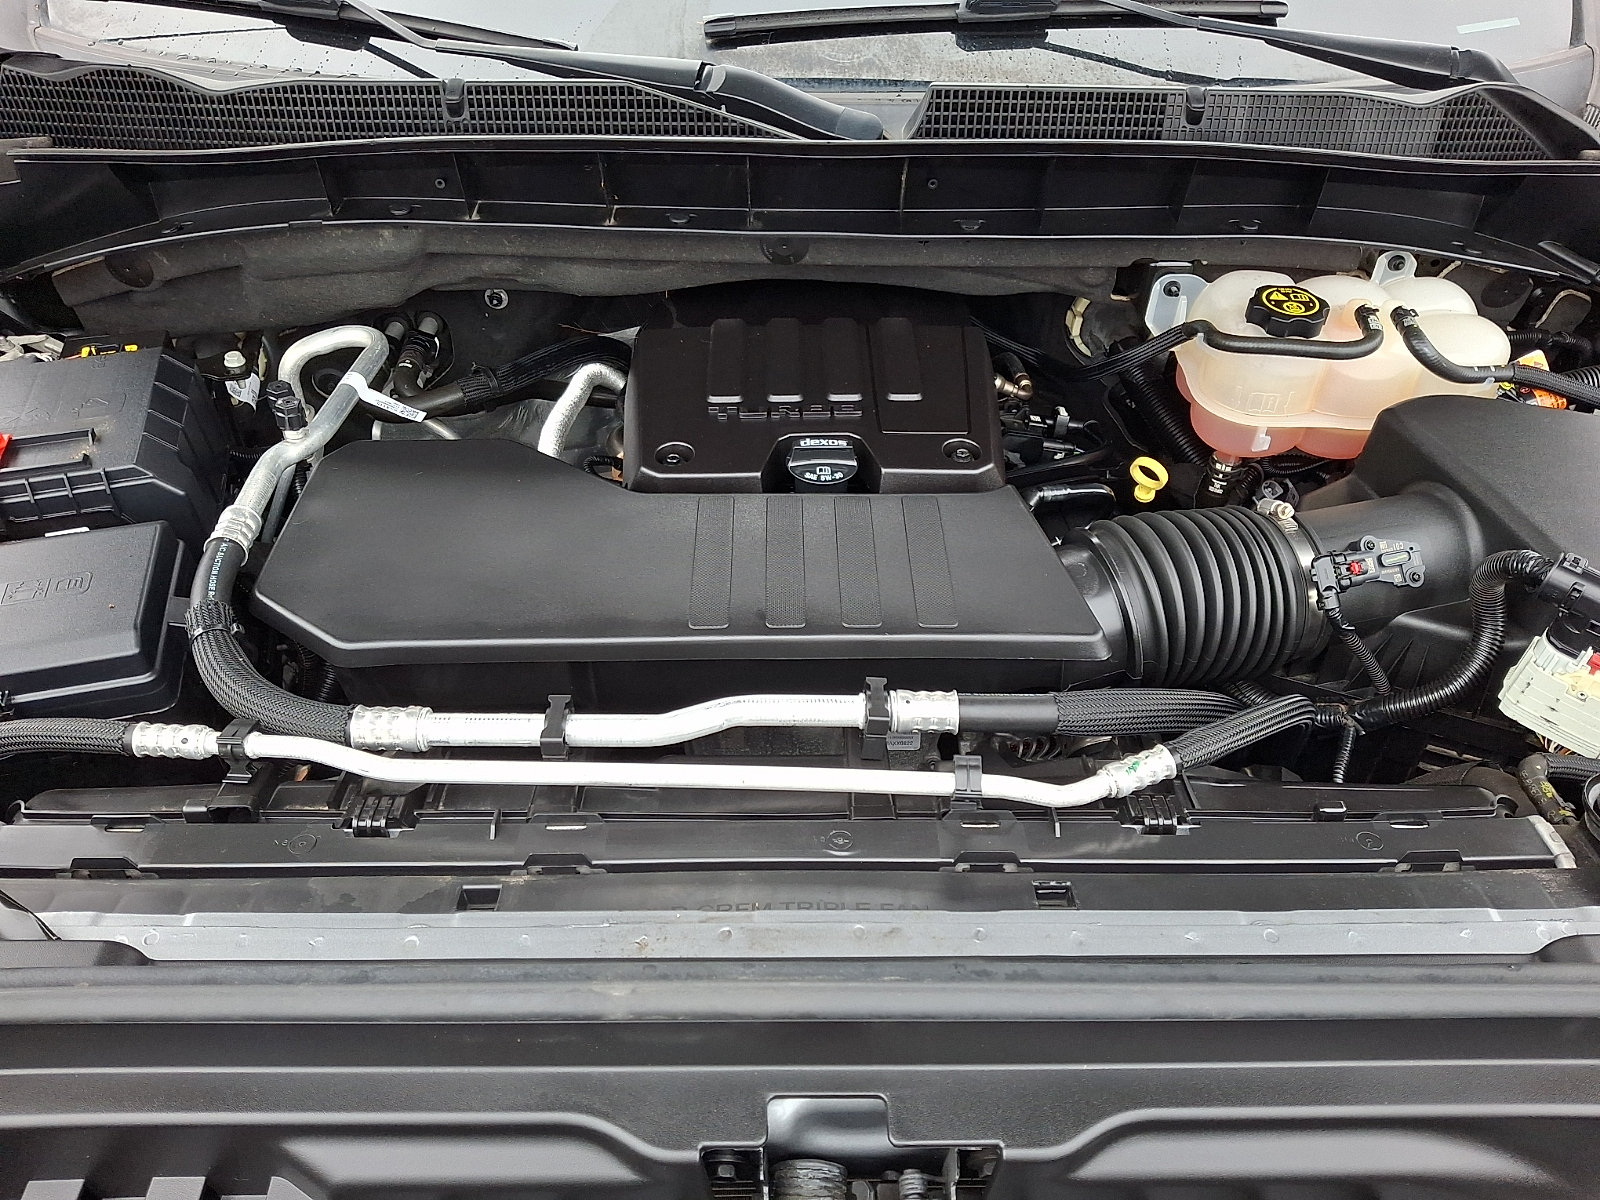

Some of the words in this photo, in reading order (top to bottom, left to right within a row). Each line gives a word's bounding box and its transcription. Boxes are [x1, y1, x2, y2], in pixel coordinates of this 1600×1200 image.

[800, 438, 848, 447] dexos
[804, 472, 818, 480] SAE
[208, 575, 218, 591] HOSE
